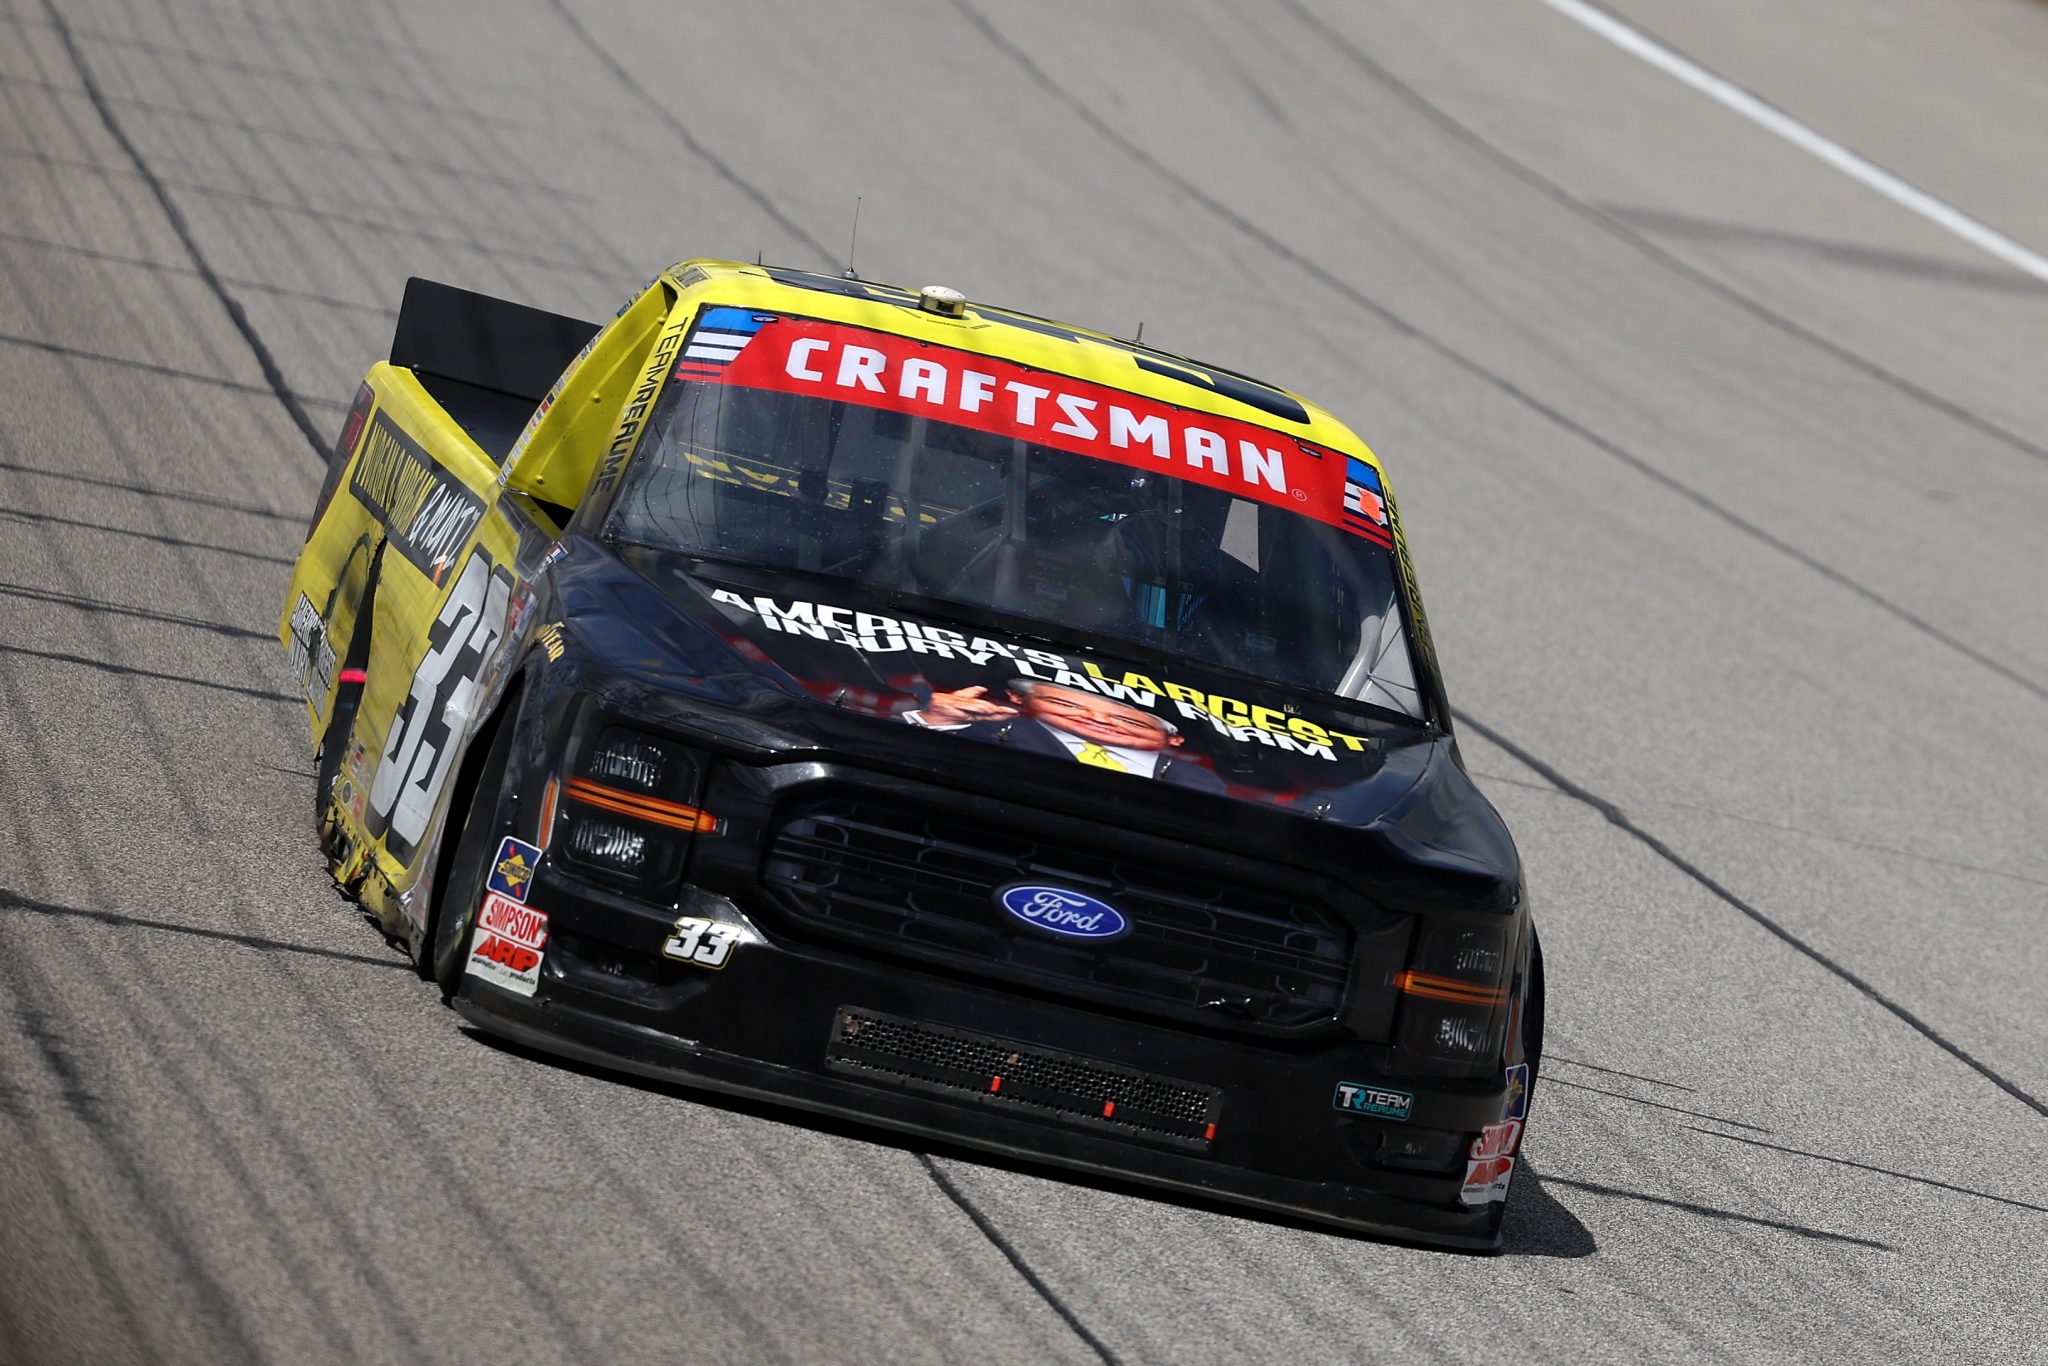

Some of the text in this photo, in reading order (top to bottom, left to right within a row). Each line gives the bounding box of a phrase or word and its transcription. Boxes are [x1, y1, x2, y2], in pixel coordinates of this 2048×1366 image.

[785, 336, 1288, 494] CRAFTSMAN
[711, 588, 1369, 752] AMERICA'S LARGEST
[760, 613, 1338, 762] INJURY LAW FIRM
[368, 551, 511, 848] 33
[486, 898, 542, 943] SIMPSON
[1023, 891, 1104, 932] Ford
[474, 935, 539, 973] ARP
[664, 916, 743, 967] 33
[1363, 1103, 1408, 1117] REAUME
[1366, 1090, 1411, 1109] TEAM
